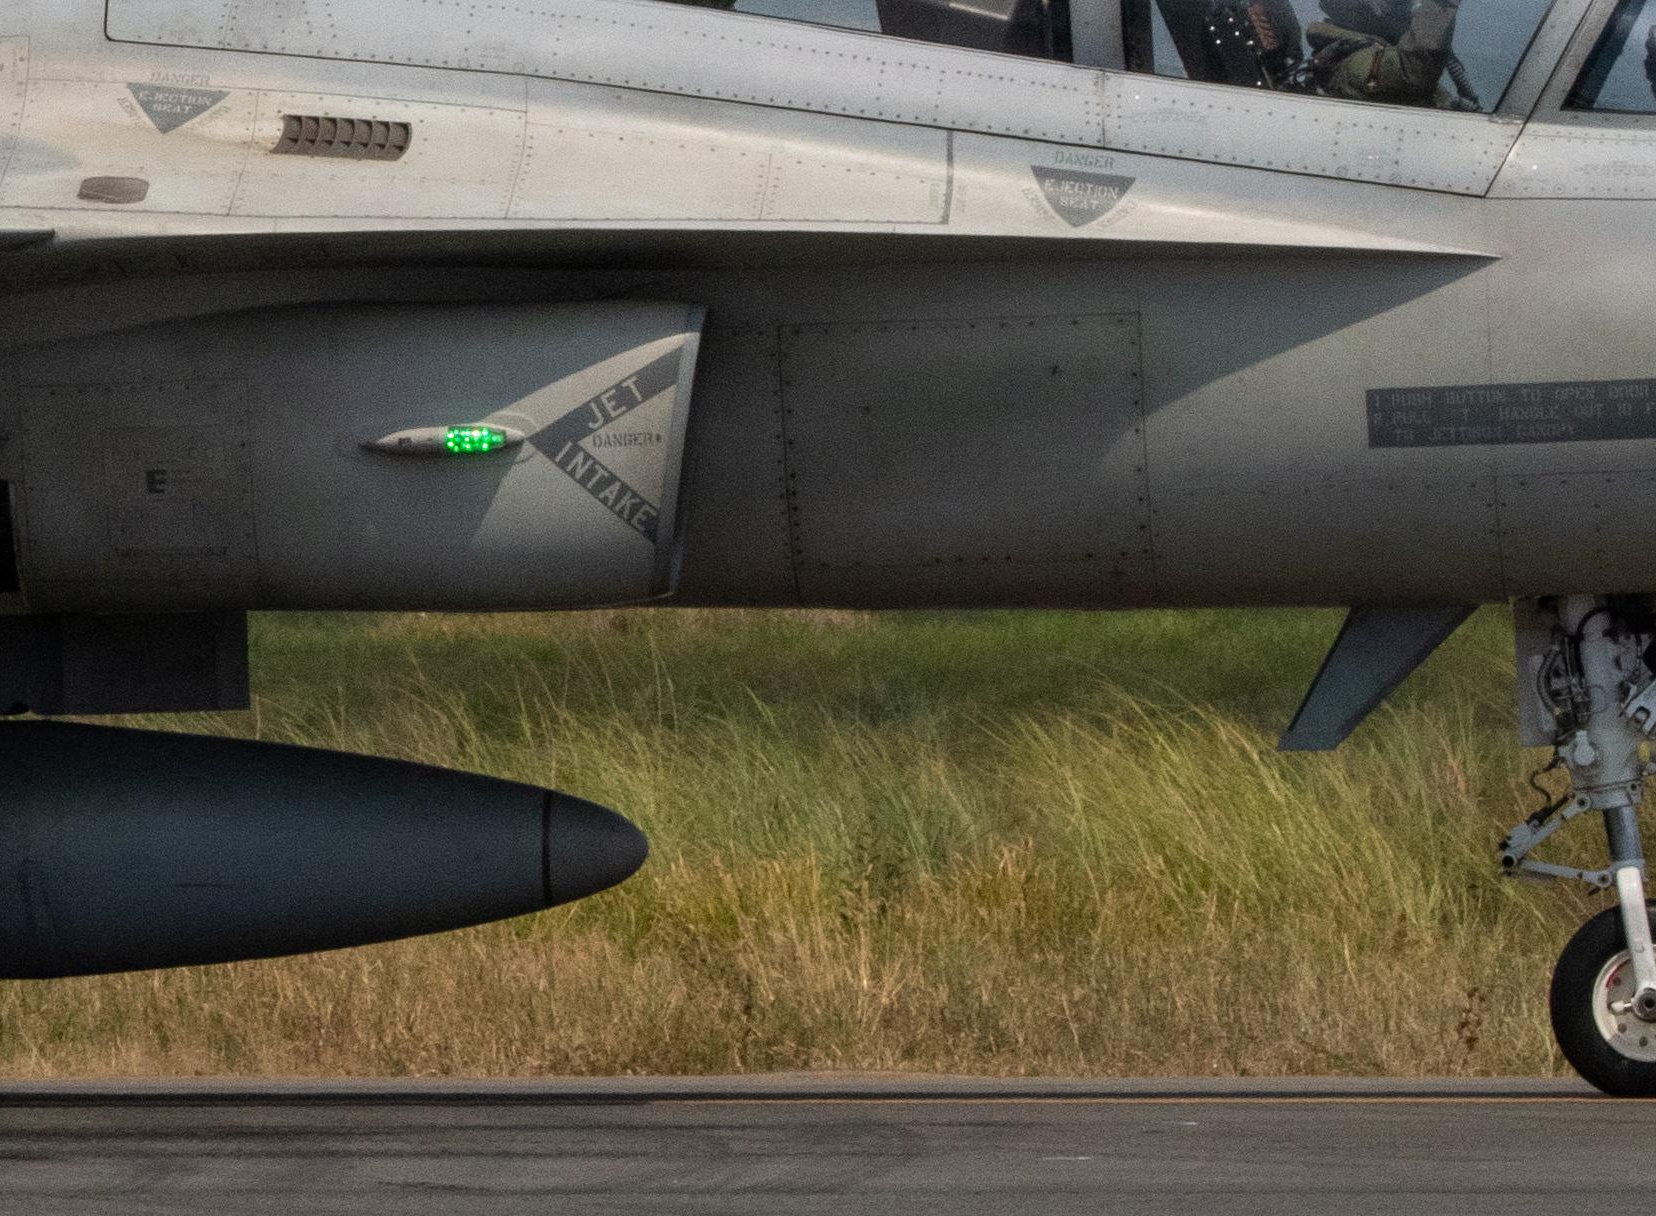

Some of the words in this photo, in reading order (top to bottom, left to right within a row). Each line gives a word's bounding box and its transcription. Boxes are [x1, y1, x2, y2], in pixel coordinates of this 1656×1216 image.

[150, 71, 210, 87] DANGER
[138, 90, 212, 106] EJECTION
[152, 103, 192, 115] SEAT
[1054, 150, 1115, 169] DANGER
[1044, 178, 1119, 200] EJECTION
[1059, 195, 1100, 211] SEAT
[588, 376, 642, 429] JET
[592, 433, 653, 449] DANGER
[555, 441, 658, 532] INTAKE
